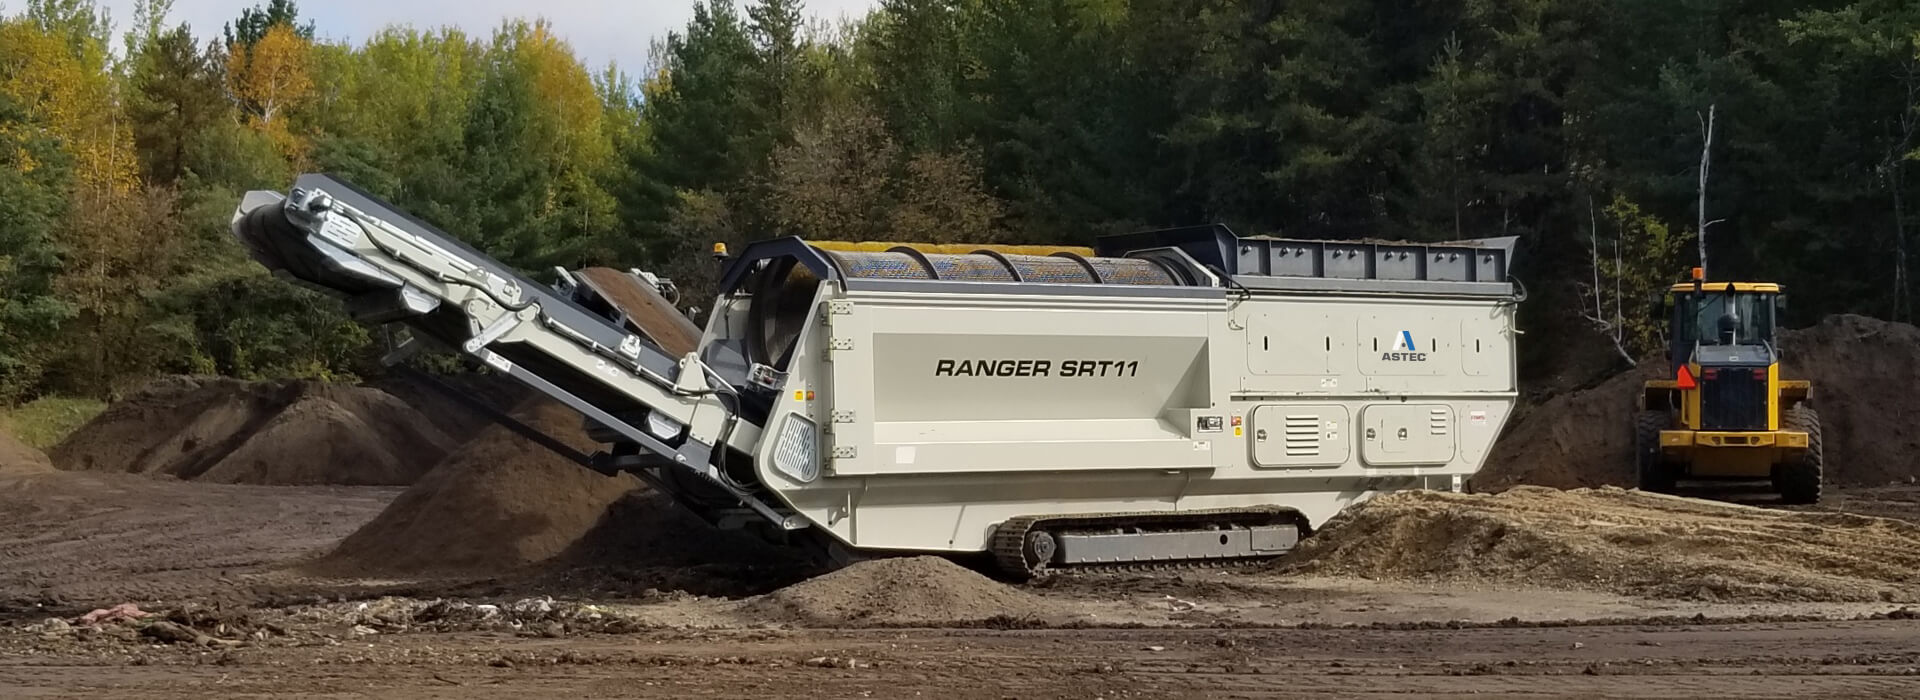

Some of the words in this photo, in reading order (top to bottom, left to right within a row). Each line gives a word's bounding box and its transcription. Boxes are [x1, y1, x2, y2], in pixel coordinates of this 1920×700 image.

[1381, 352, 1427, 362] ASTEC
[935, 359, 1051, 377] RANGER
[1059, 360, 1139, 377] SRT11
